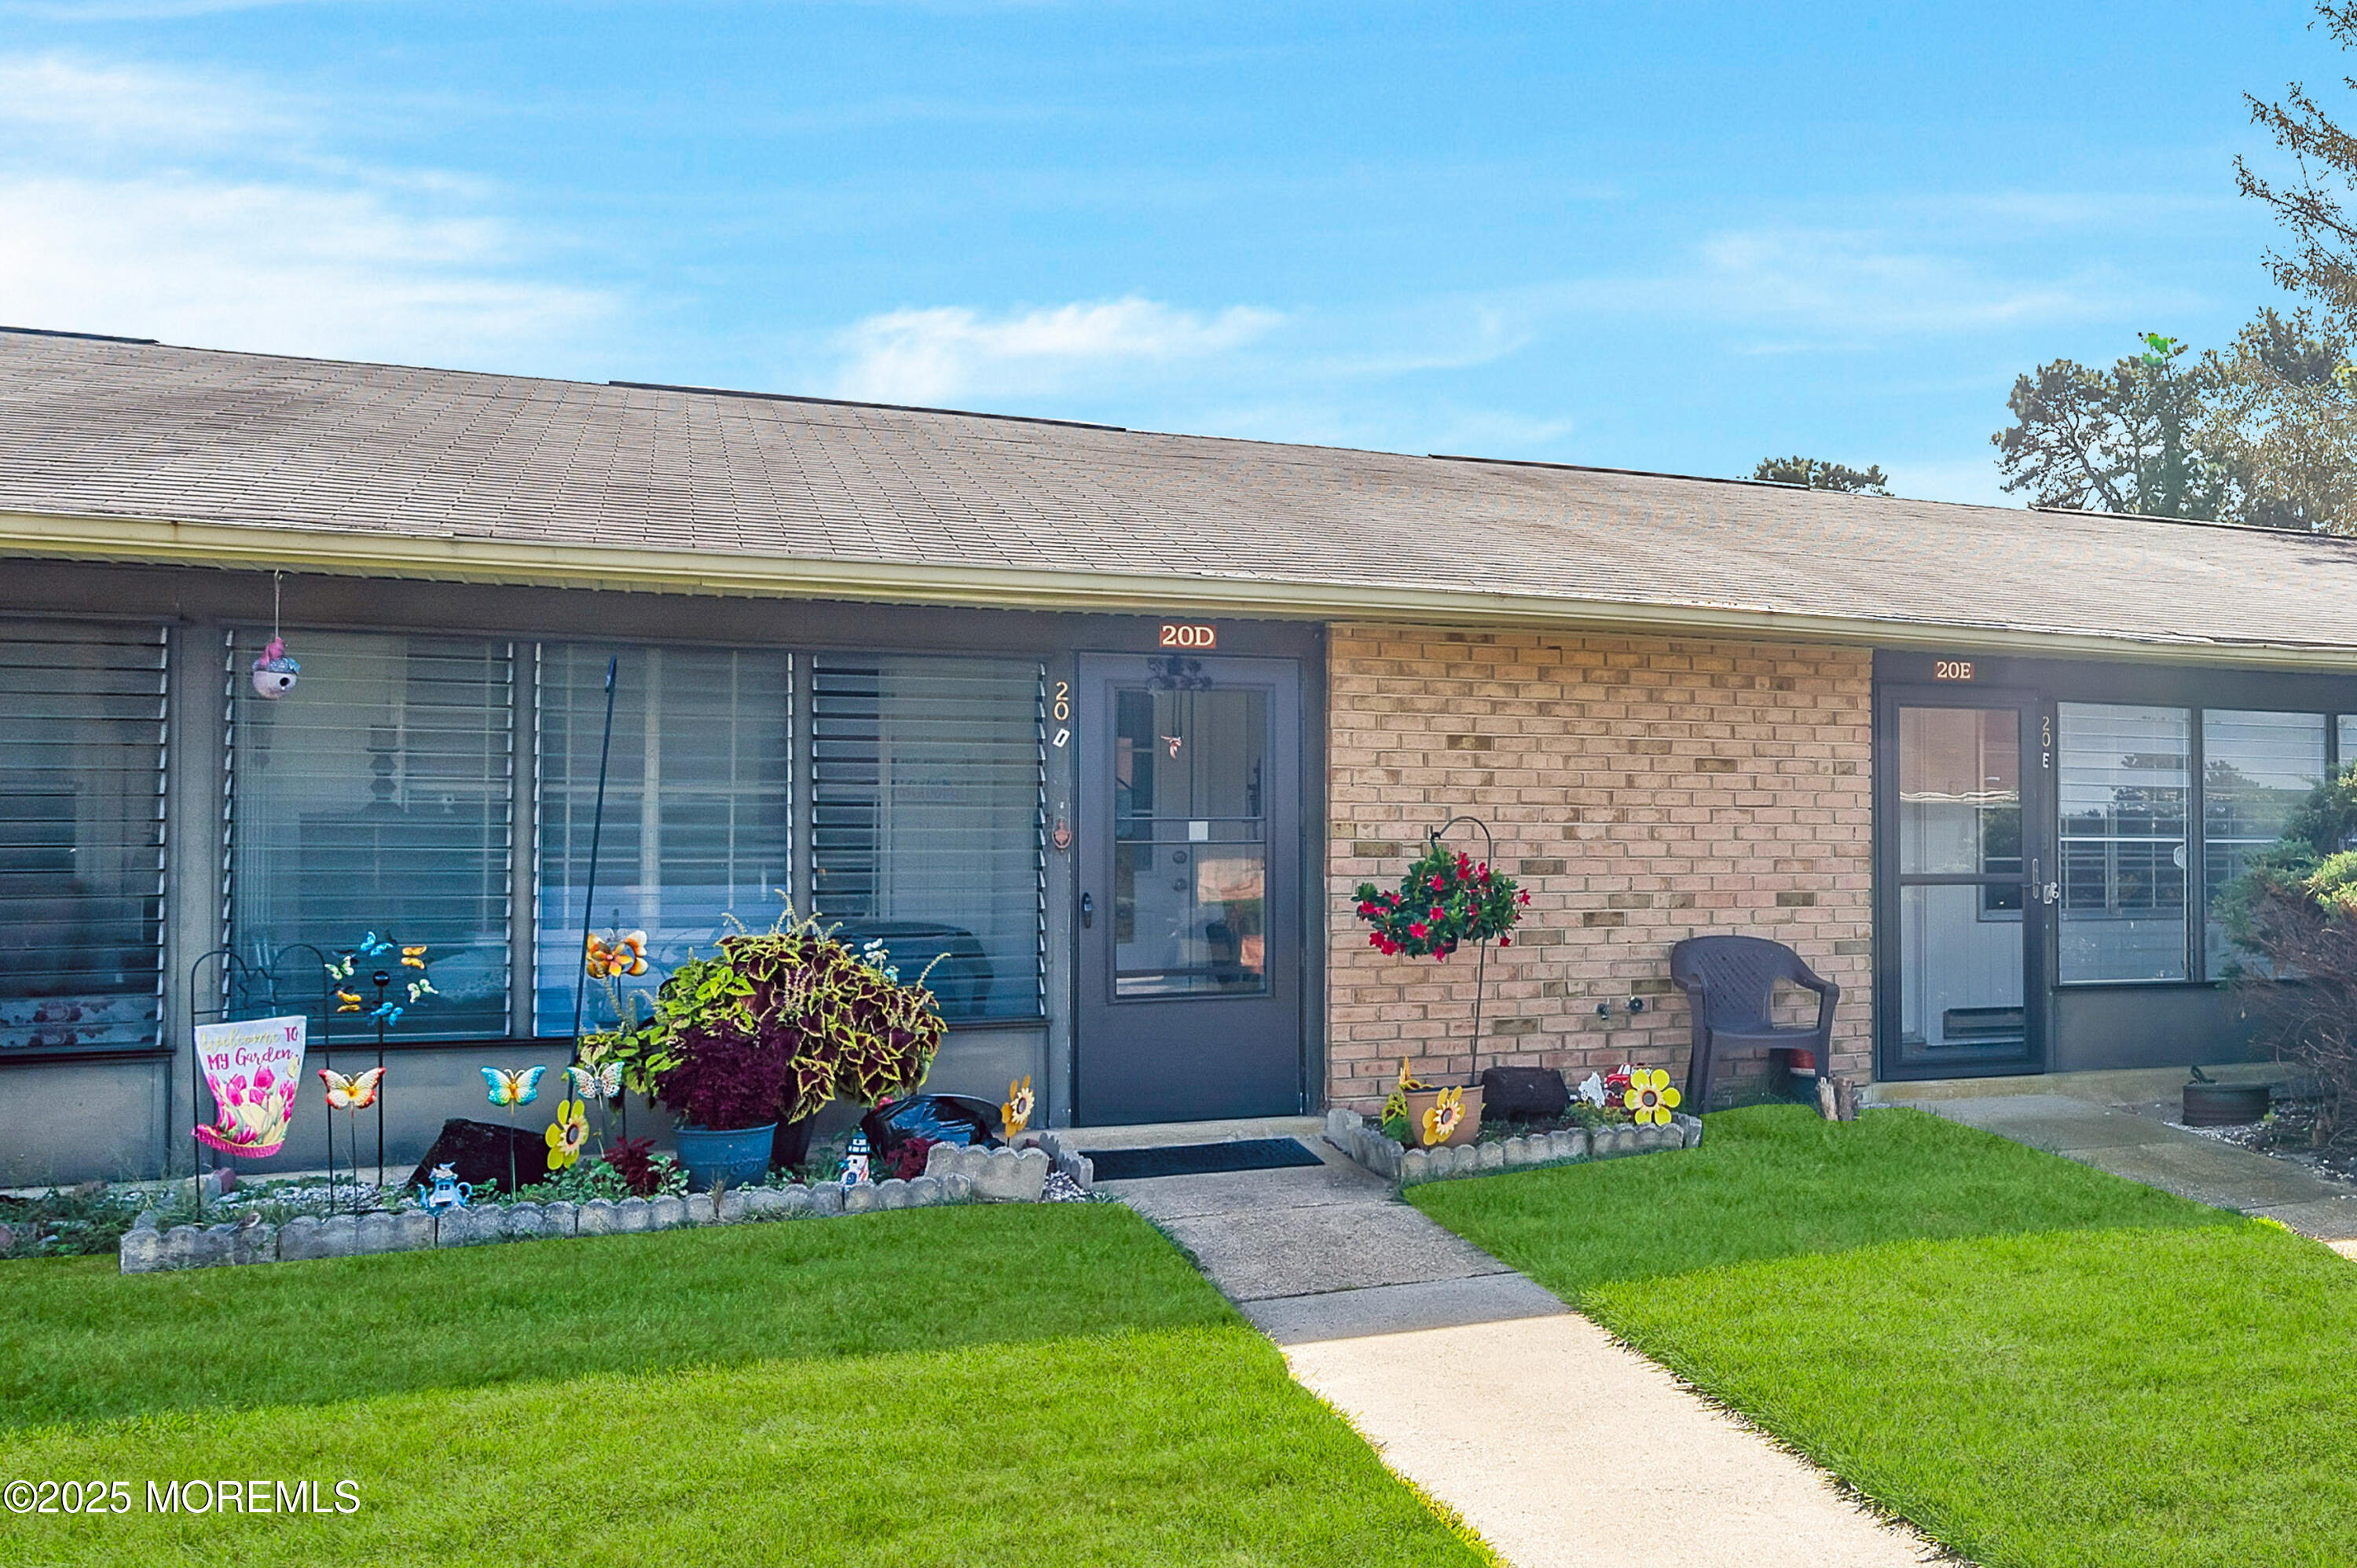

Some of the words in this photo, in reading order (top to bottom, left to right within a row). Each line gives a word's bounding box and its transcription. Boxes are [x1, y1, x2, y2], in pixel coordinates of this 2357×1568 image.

[1162, 625, 1215, 647] 20D
[1937, 661, 1971, 679] 20E
[236, 1046, 294, 1067] Garden
